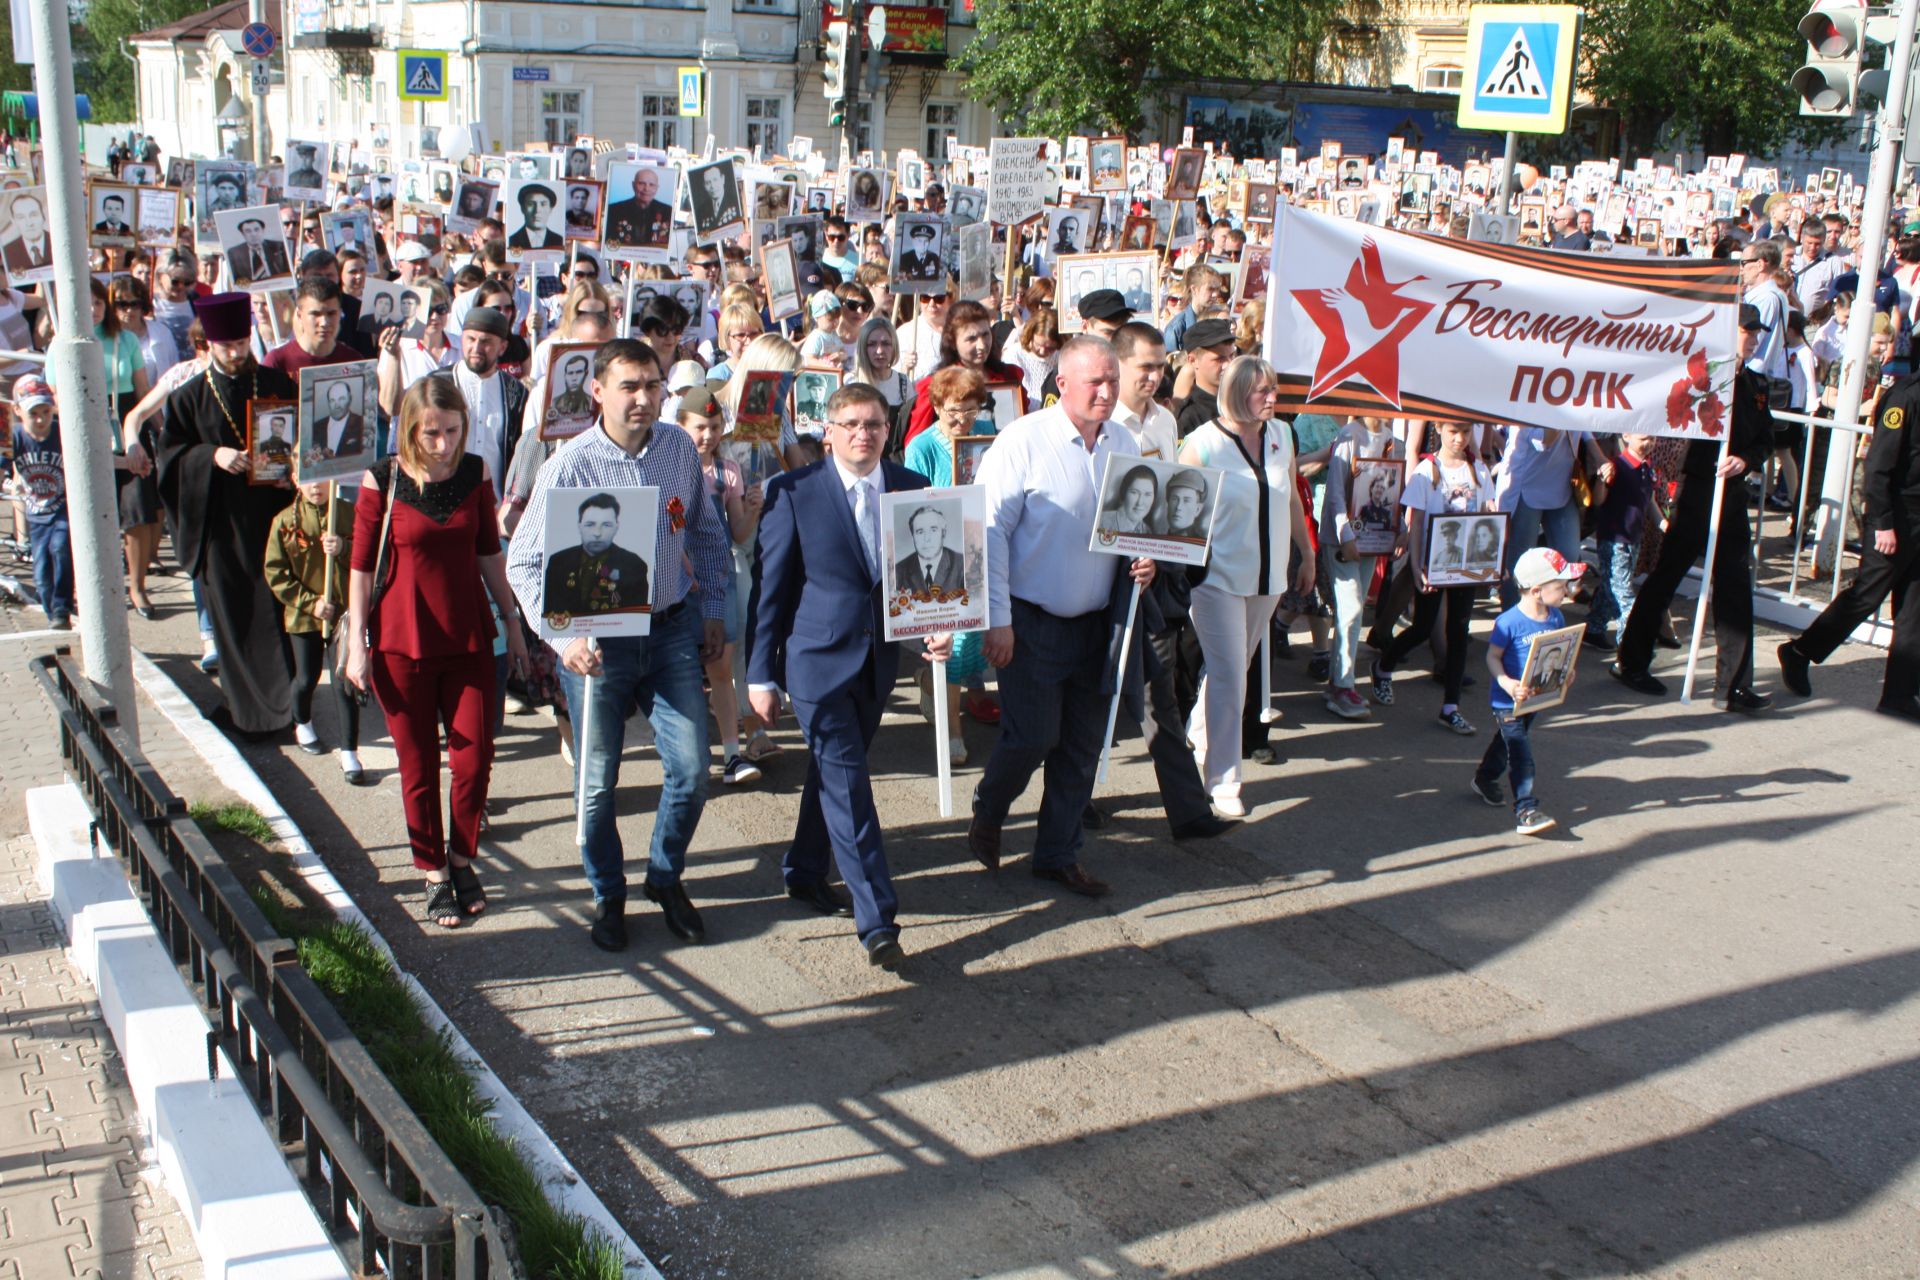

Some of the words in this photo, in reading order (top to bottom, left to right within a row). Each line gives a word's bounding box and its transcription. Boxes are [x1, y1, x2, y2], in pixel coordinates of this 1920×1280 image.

[254, 76, 268, 86] 50
[1000, 210, 1023, 223] ВМФ
[1435, 278, 1716, 358] Бессмертный
[1509, 364, 1636, 411] ПОЛК
[893, 619, 956, 636] БЕССМЕРТНЫЙ
[957, 617, 983, 628] ПОЛК
